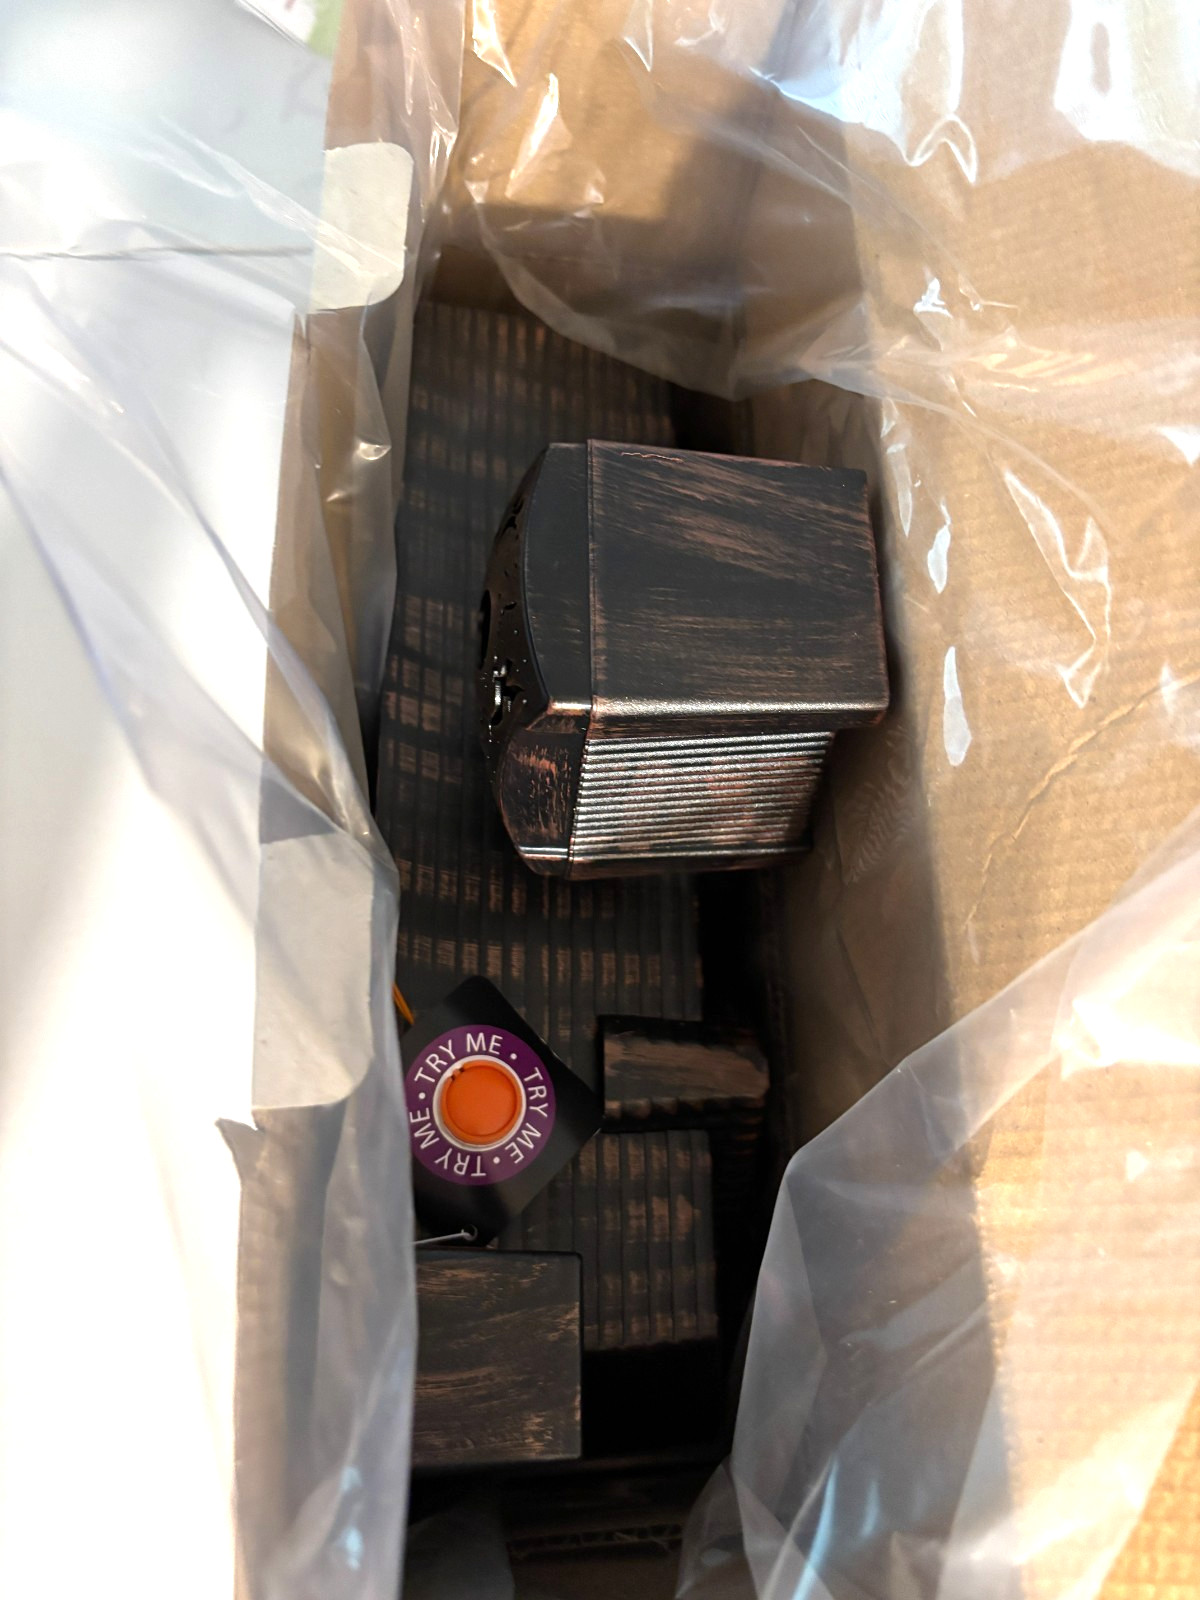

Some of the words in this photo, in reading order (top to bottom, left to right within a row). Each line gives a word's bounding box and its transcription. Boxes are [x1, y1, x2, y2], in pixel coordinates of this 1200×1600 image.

[414, 1039, 457, 1083] TRY
[466, 1032, 503, 1055] ME
[524, 1067, 549, 1118] TRY
[409, 1107, 440, 1150] ME
[505, 1123, 542, 1164] ME
[434, 1148, 486, 1177] TRY
